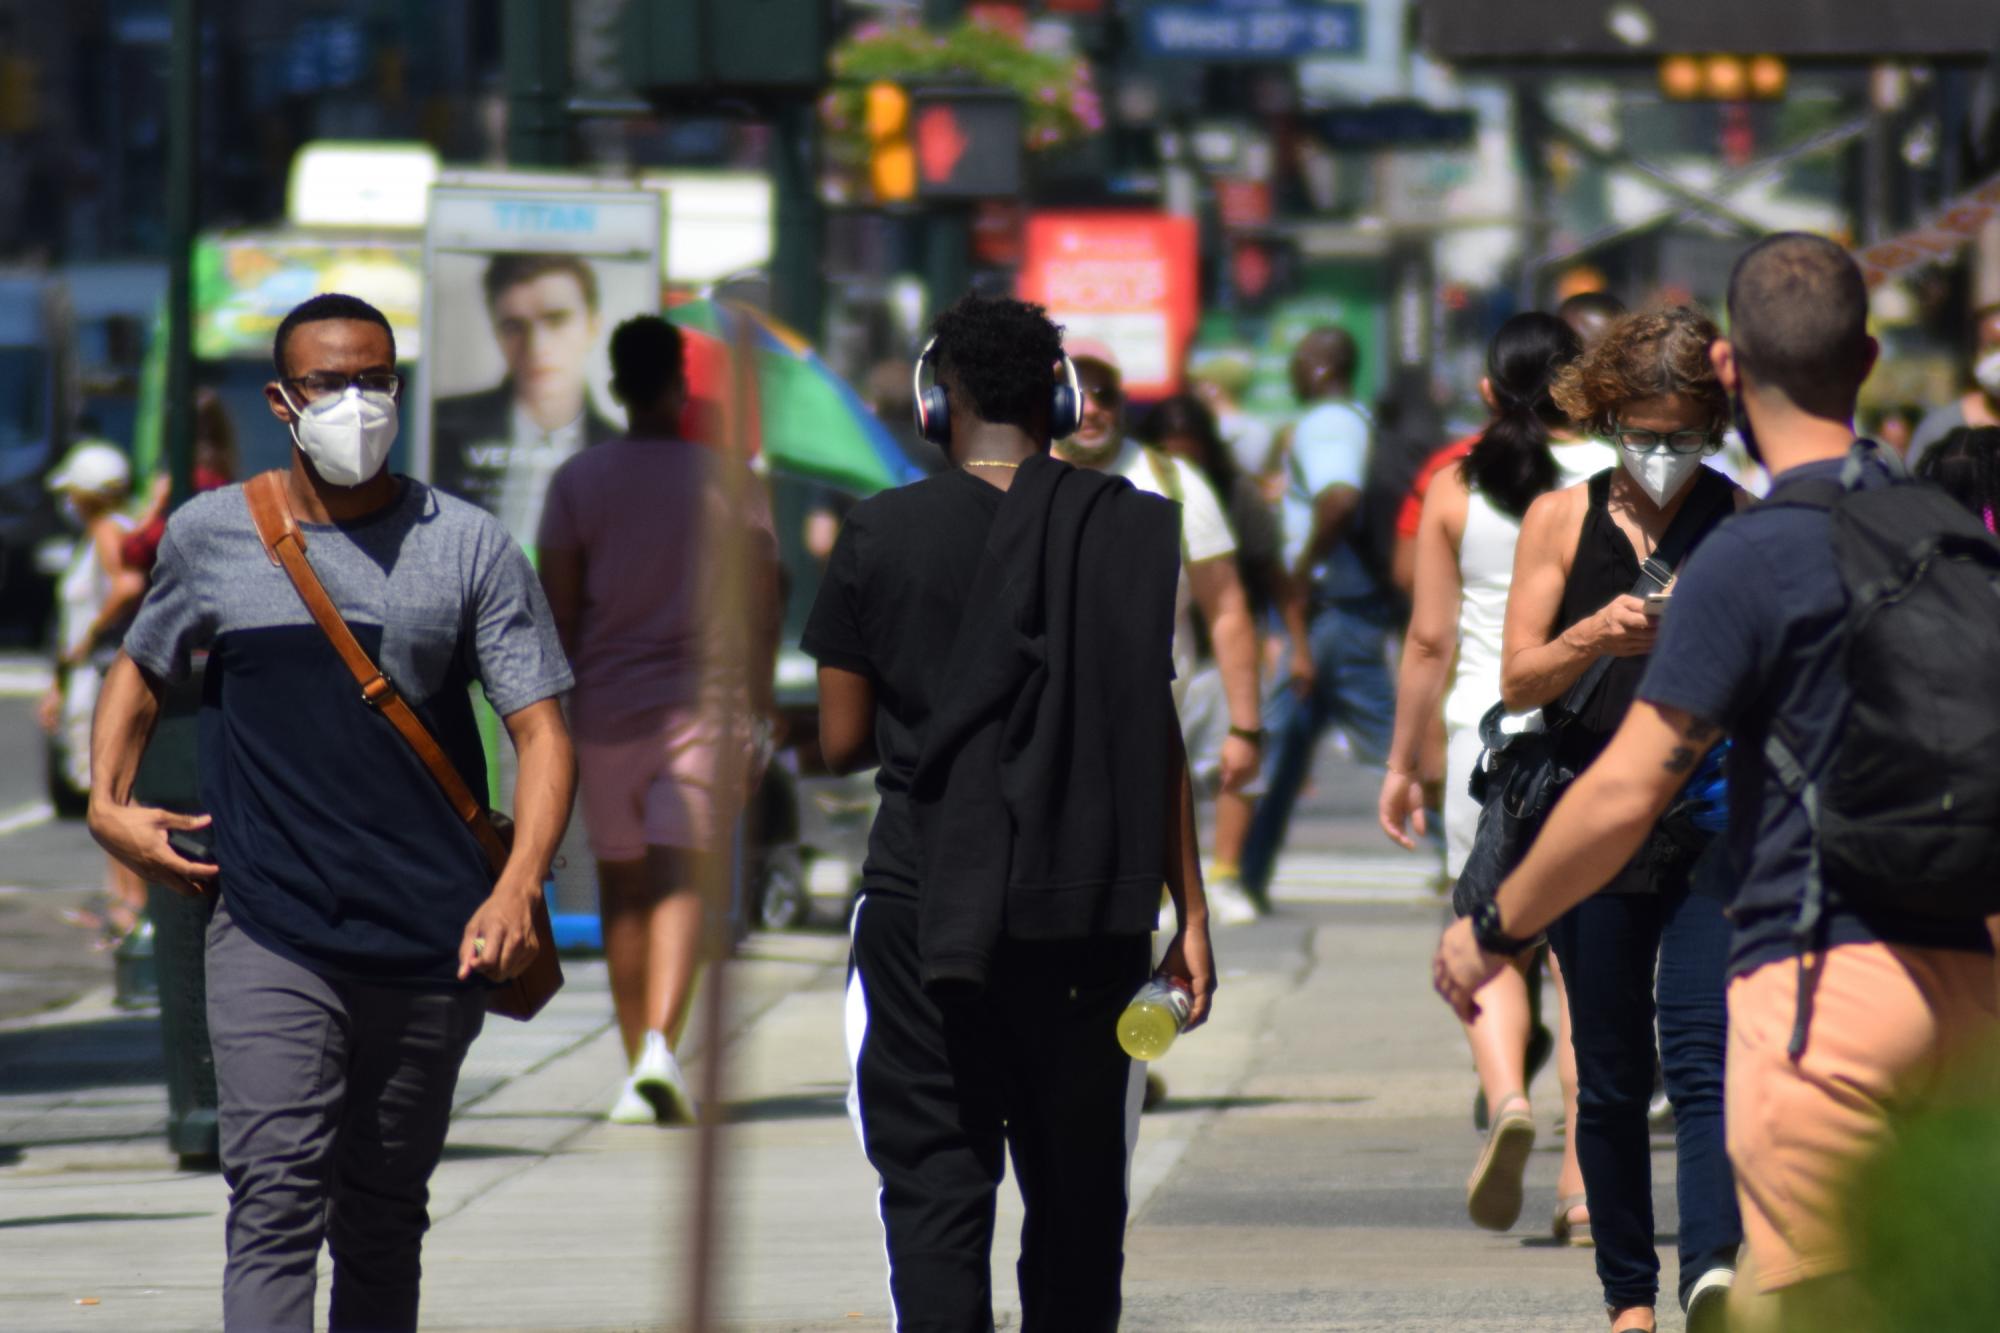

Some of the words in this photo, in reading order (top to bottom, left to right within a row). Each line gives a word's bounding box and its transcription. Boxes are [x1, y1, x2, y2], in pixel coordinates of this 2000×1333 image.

[1153, 14, 1241, 49] West
[1312, 15, 1348, 49] St
[493, 202, 596, 231] TITAN
